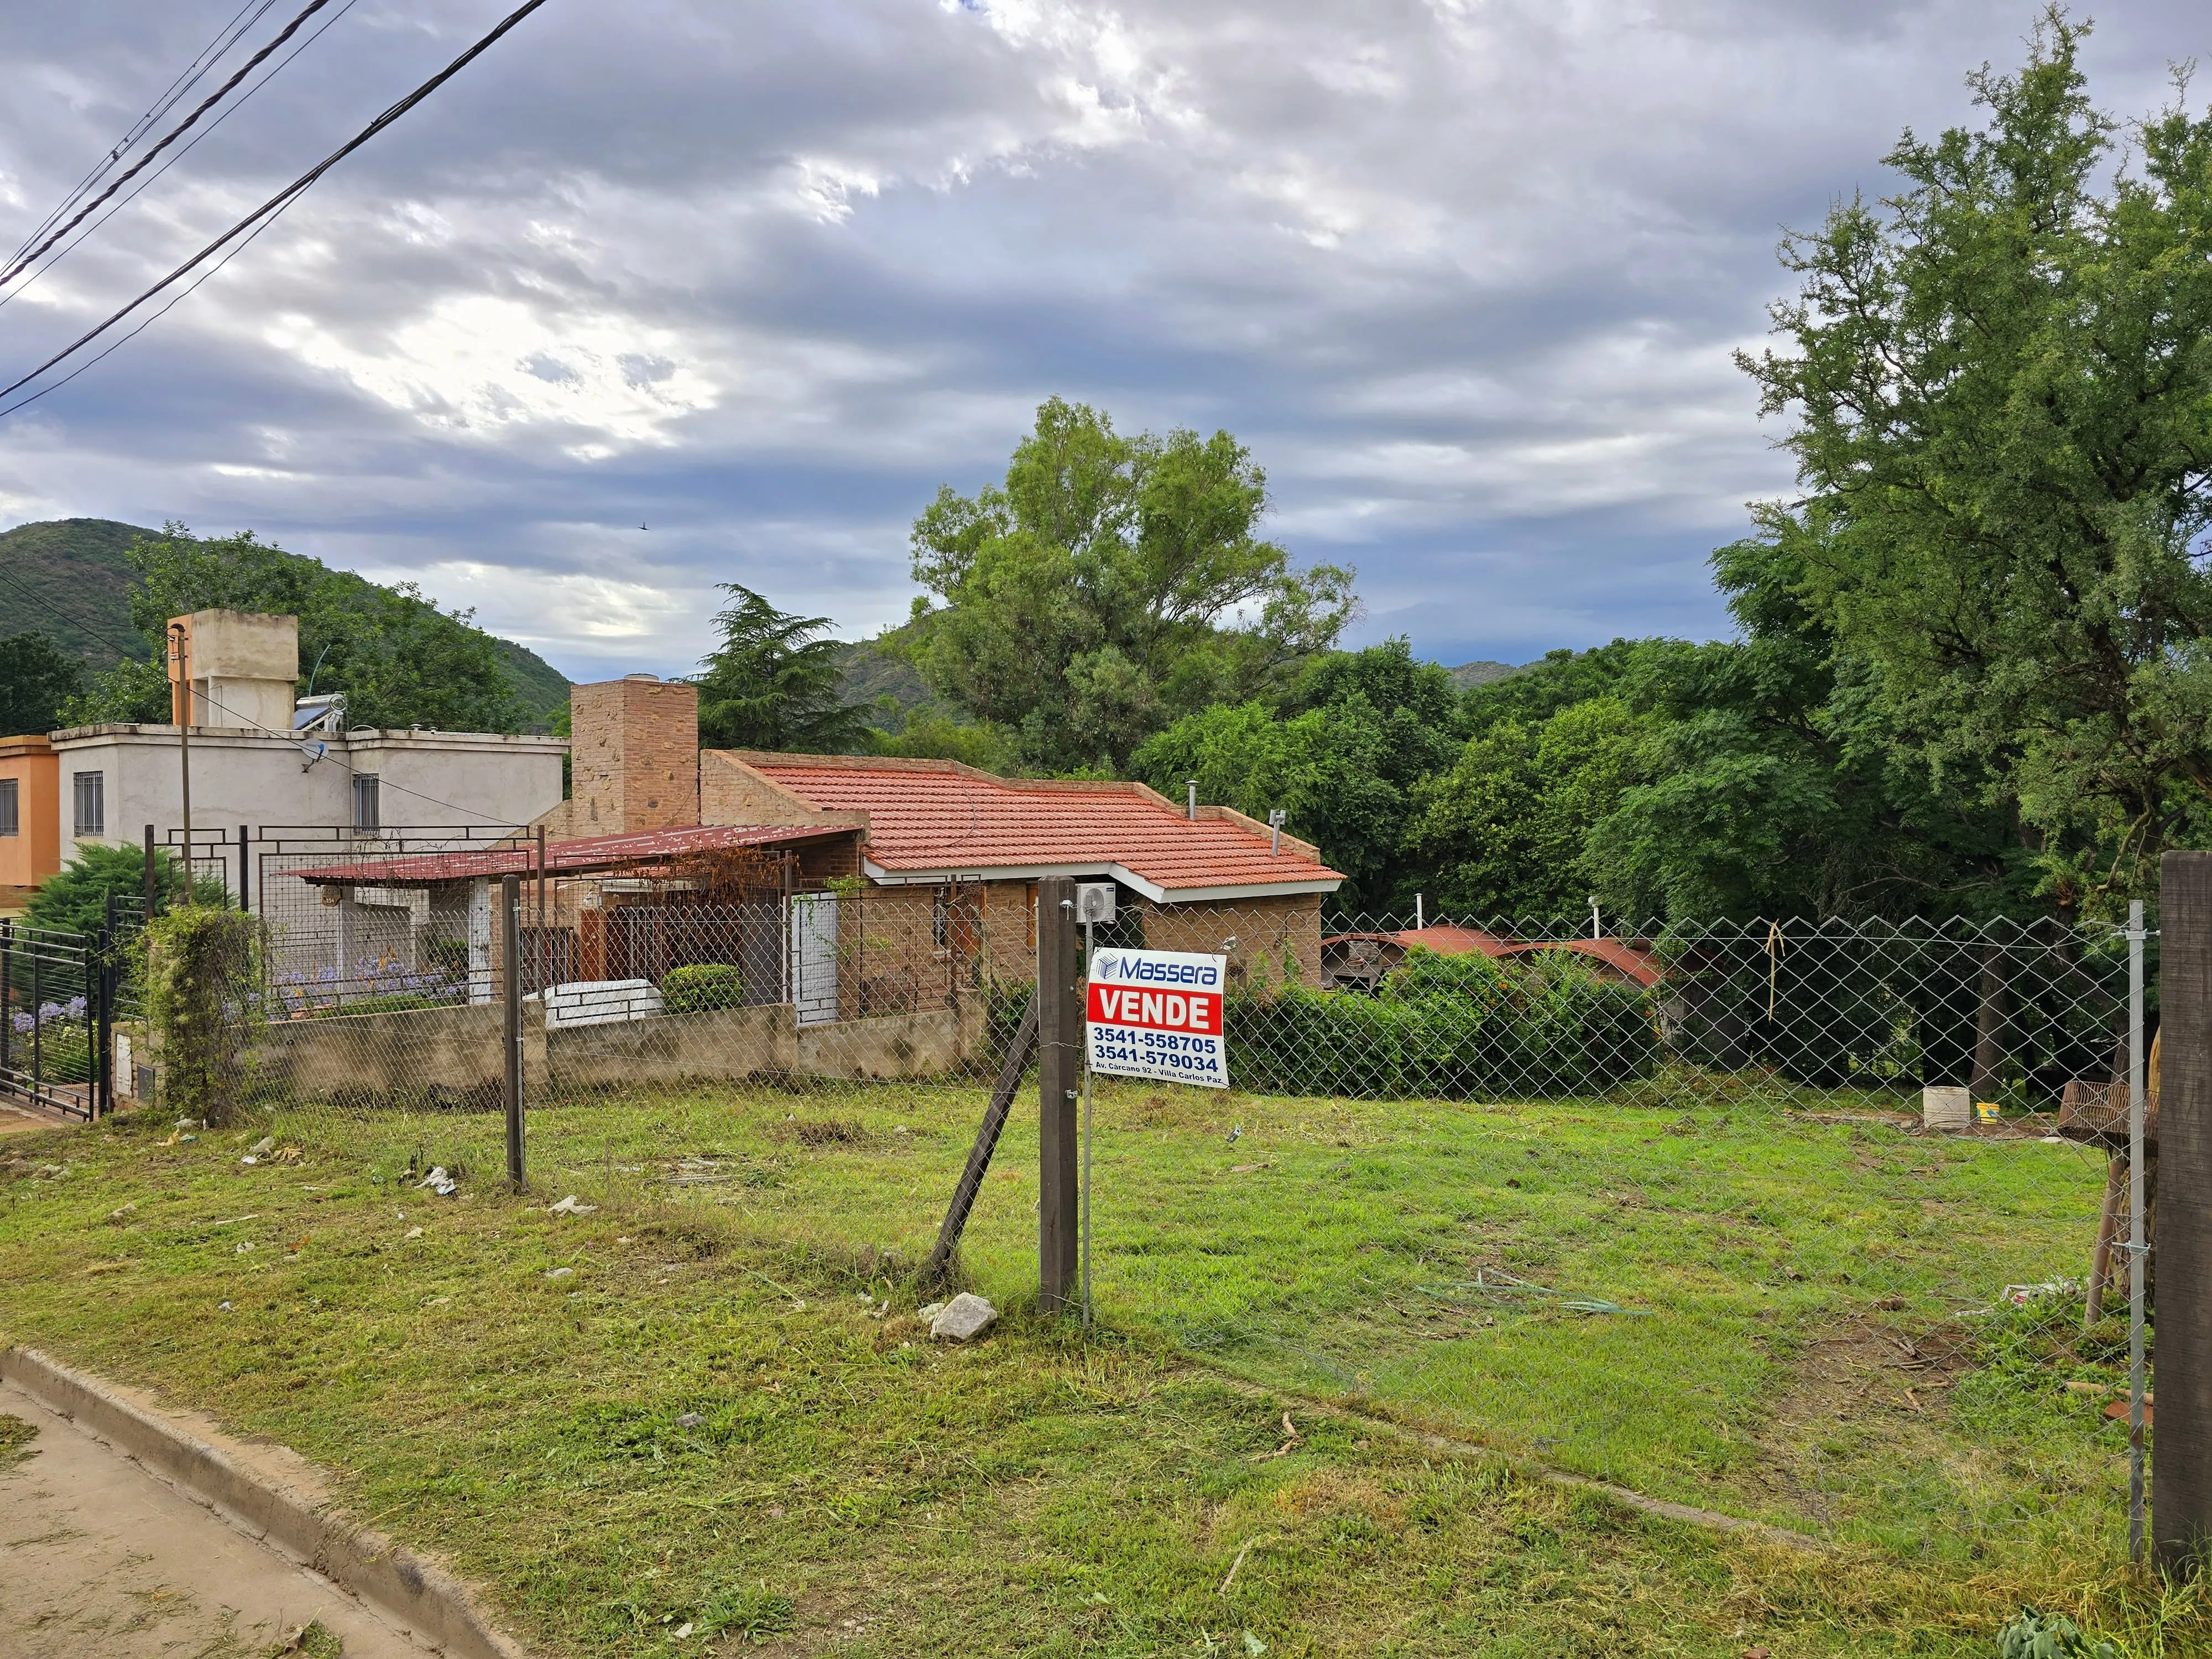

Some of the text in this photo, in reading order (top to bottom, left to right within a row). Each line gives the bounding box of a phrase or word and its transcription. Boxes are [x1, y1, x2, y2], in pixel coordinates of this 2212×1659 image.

[1119, 956, 1217, 985] Massera
[1099, 988, 1209, 1030] VENDE
[1093, 1027, 1216, 1054] 3541-558705
[1095, 1045, 1218, 1072] 3541-579034
[1108, 1063, 1140, 1072] Cárcano
[1159, 1069, 1176, 1077] Villa
[1178, 1072, 1204, 1081] Carlos
